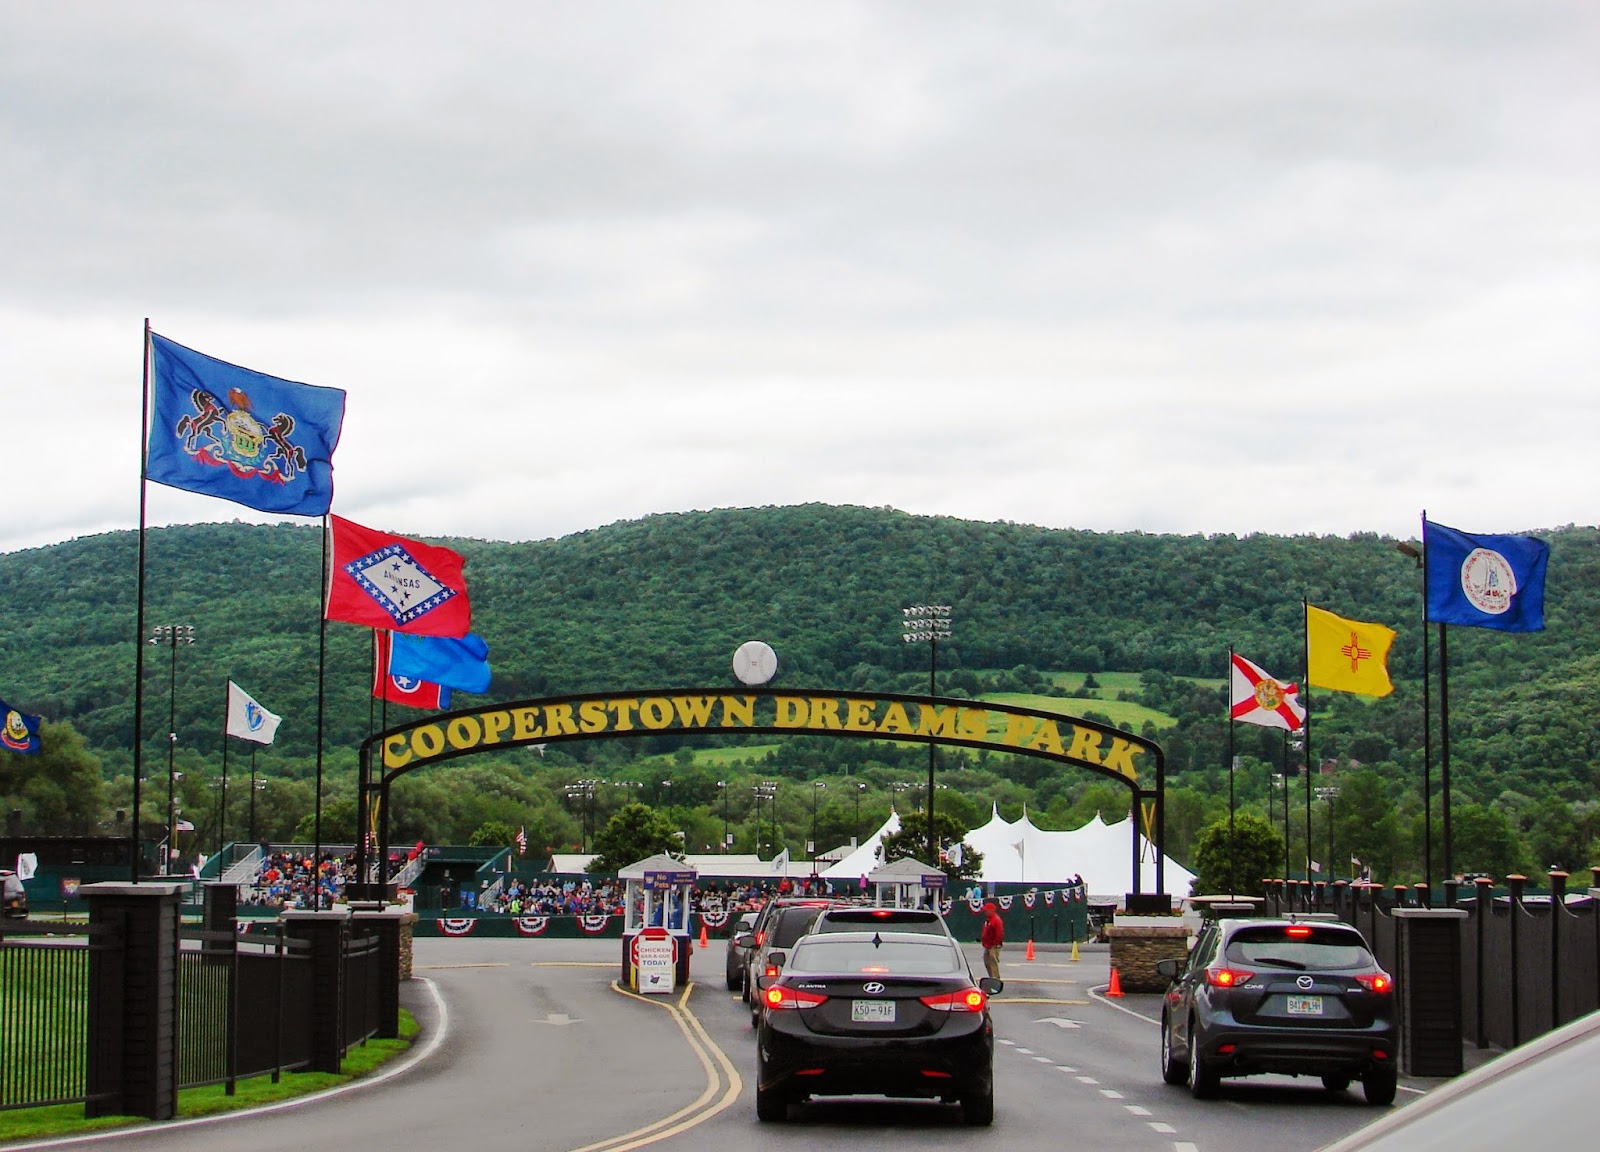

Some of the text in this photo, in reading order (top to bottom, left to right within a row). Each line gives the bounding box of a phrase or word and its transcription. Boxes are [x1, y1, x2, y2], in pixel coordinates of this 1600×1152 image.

[380, 696, 1145, 780] COOPERSTOWN DREAMS PARK
